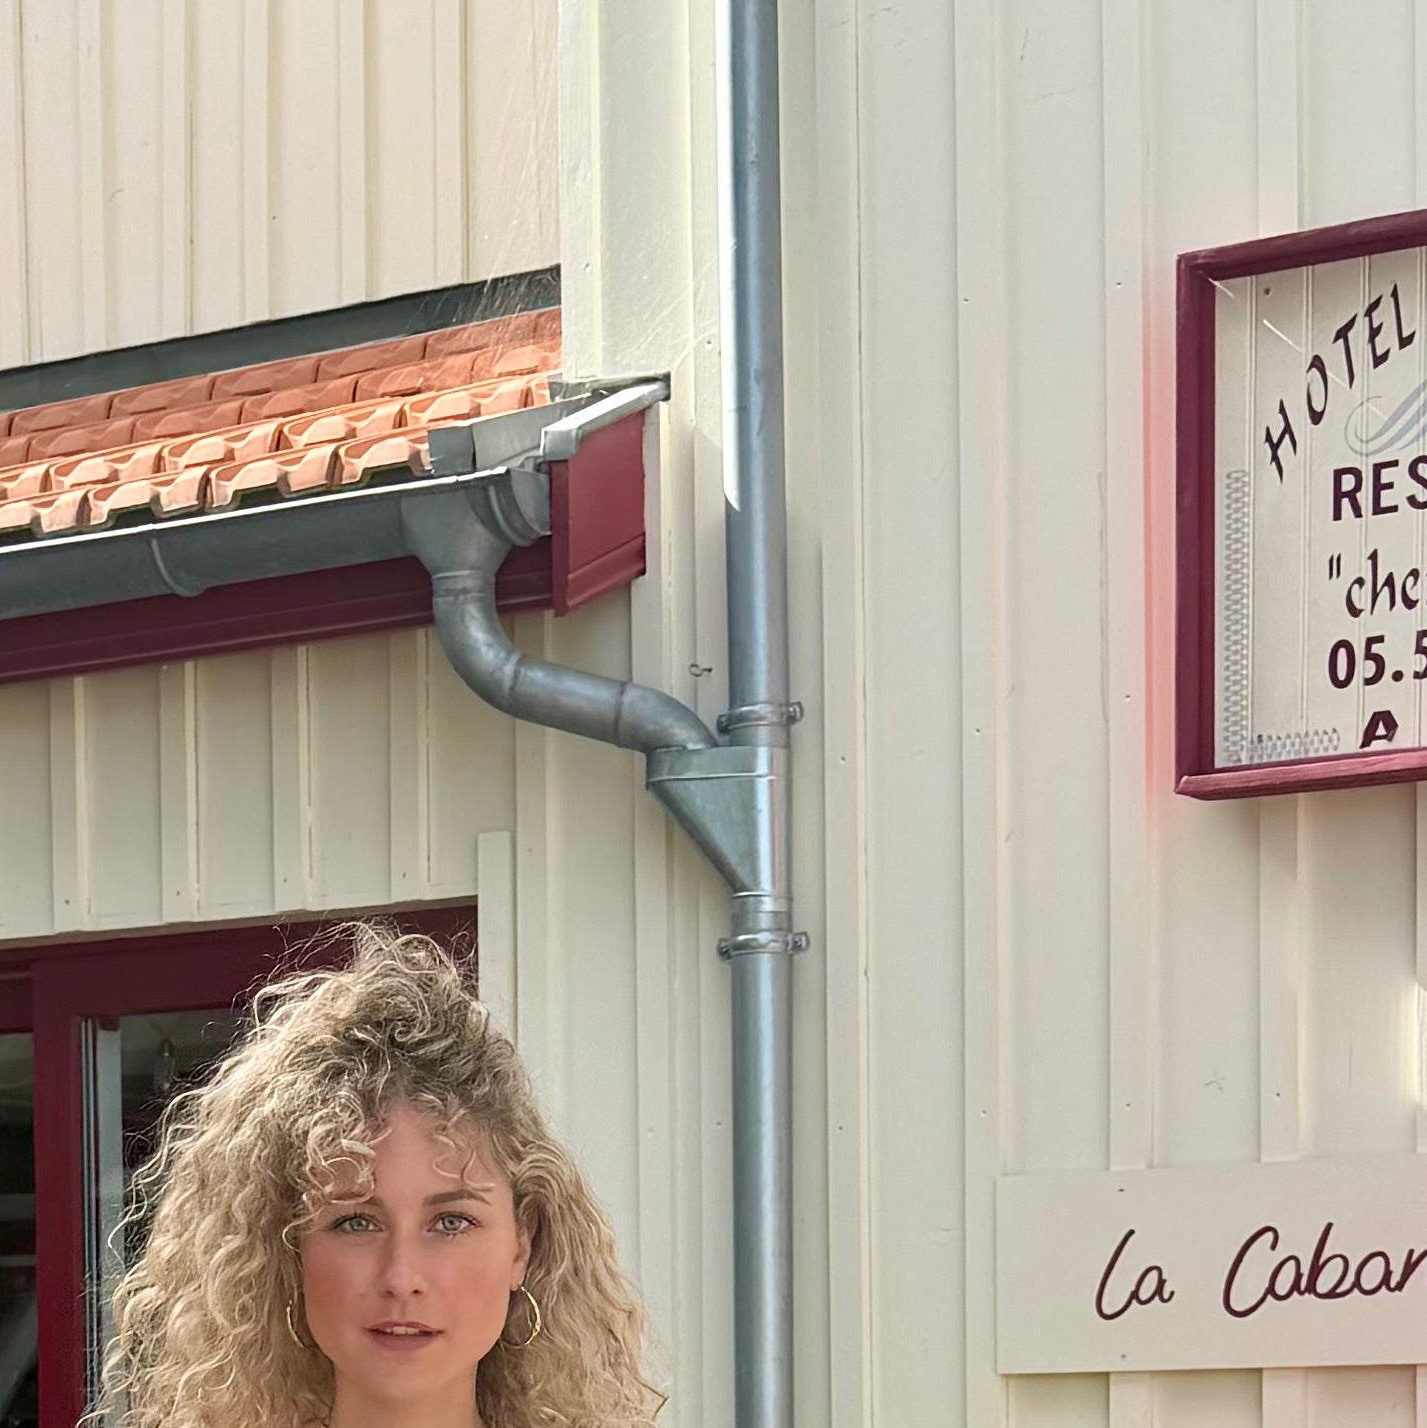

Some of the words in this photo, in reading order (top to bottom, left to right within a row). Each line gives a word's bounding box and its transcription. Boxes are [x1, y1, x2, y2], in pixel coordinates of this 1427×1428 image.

[1264, 284, 1417, 482] HOTEL
[1360, 710, 1399, 749] A
[1095, 1229, 1175, 1320] La
